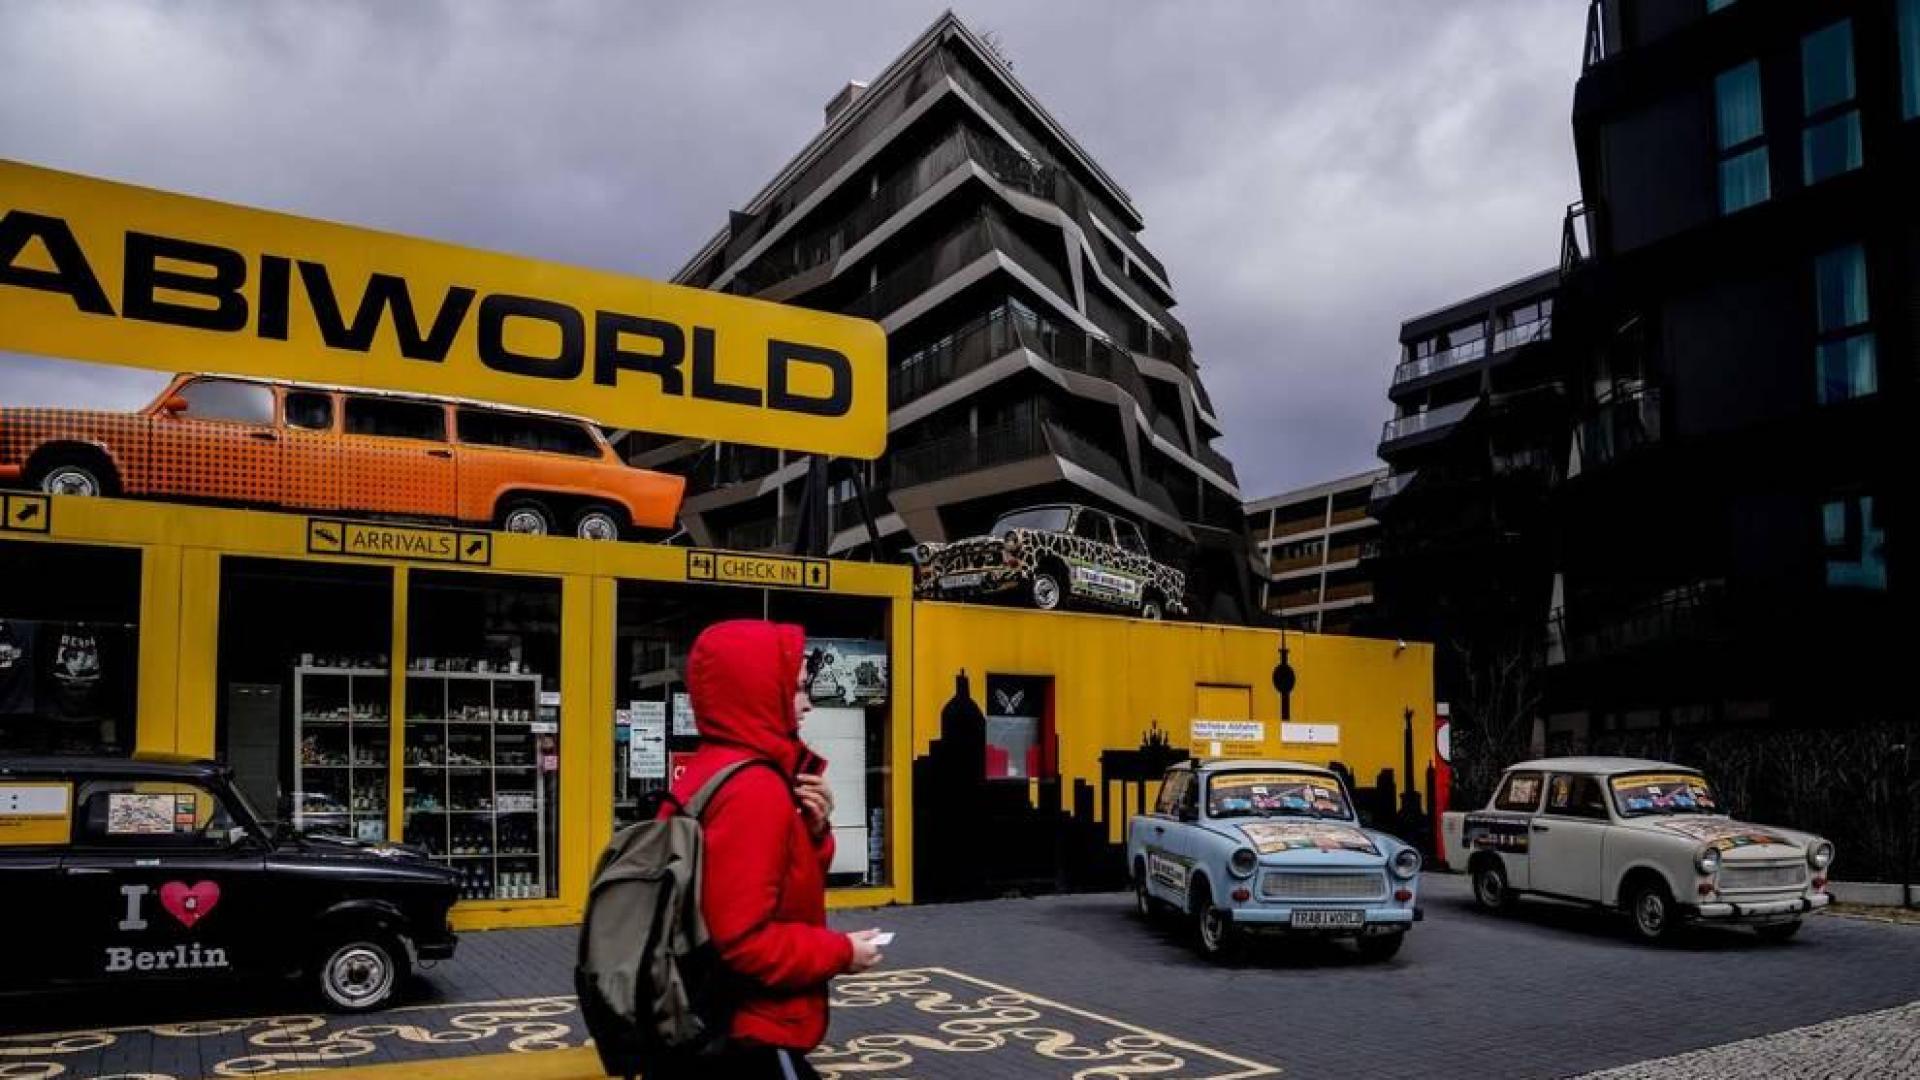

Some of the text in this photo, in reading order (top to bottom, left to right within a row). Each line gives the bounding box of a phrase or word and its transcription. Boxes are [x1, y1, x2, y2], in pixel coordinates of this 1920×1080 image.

[352, 529, 451, 554] ARRIVALS
[722, 560, 798, 580] CHECK IN
[119, 885, 149, 931] I
[105, 942, 229, 972] Berlin
